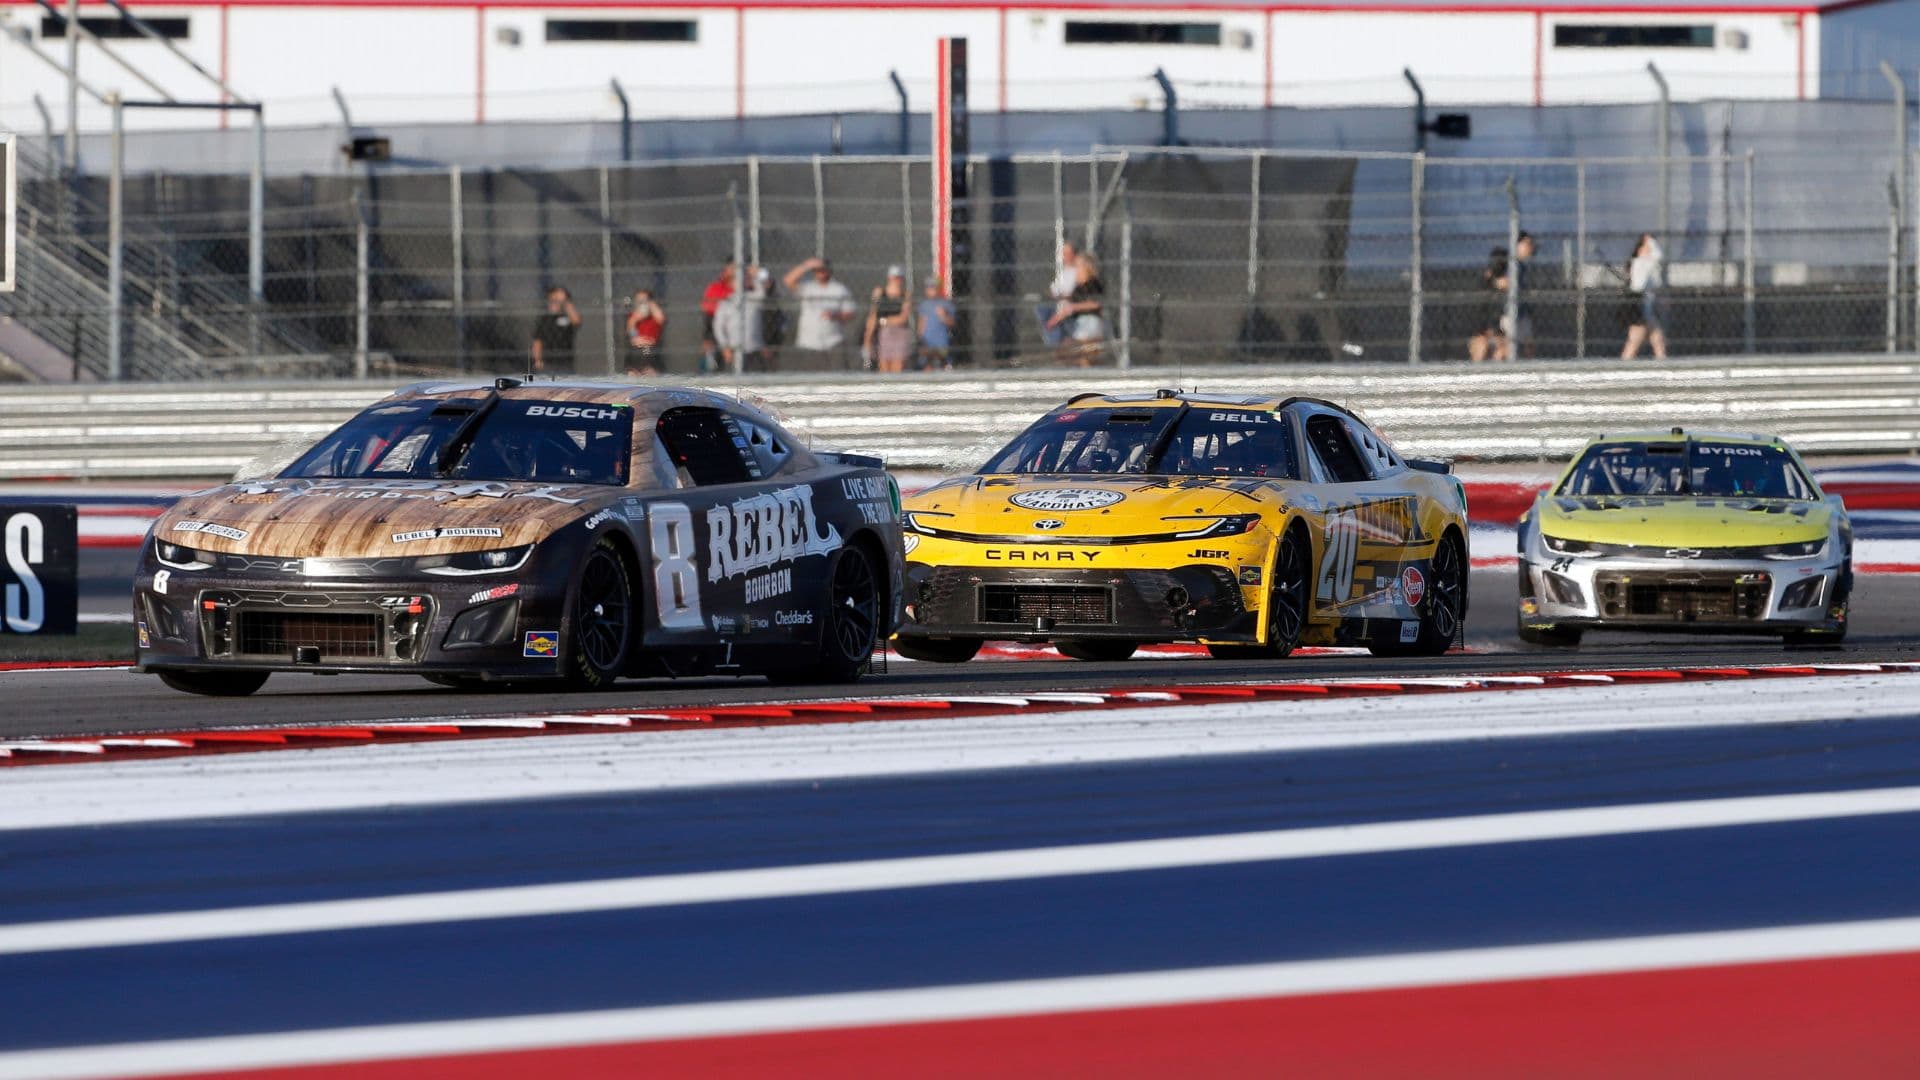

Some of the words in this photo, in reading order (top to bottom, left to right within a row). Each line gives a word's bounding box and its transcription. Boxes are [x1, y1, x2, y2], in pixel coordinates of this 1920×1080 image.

[526, 405, 618, 420] BUSCH
[1210, 412, 1268, 424] BELL
[1699, 447, 1762, 457] BYRON
[841, 478, 867, 499] LIVE
[396, 531, 433, 541] REBEL
[446, 528, 499, 536] BOURBON
[707, 484, 844, 584] REBEL
[985, 549, 1101, 561] CAMRY
[1187, 548, 1229, 559] JGR
[1316, 510, 1358, 604] 20
[0, 512, 45, 633] S
[648, 502, 706, 628] 8
[1551, 557, 1575, 573] 24
[153, 570, 172, 594] 8
[745, 568, 792, 604] BOURBON
[775, 610, 813, 625] Cheddar's
